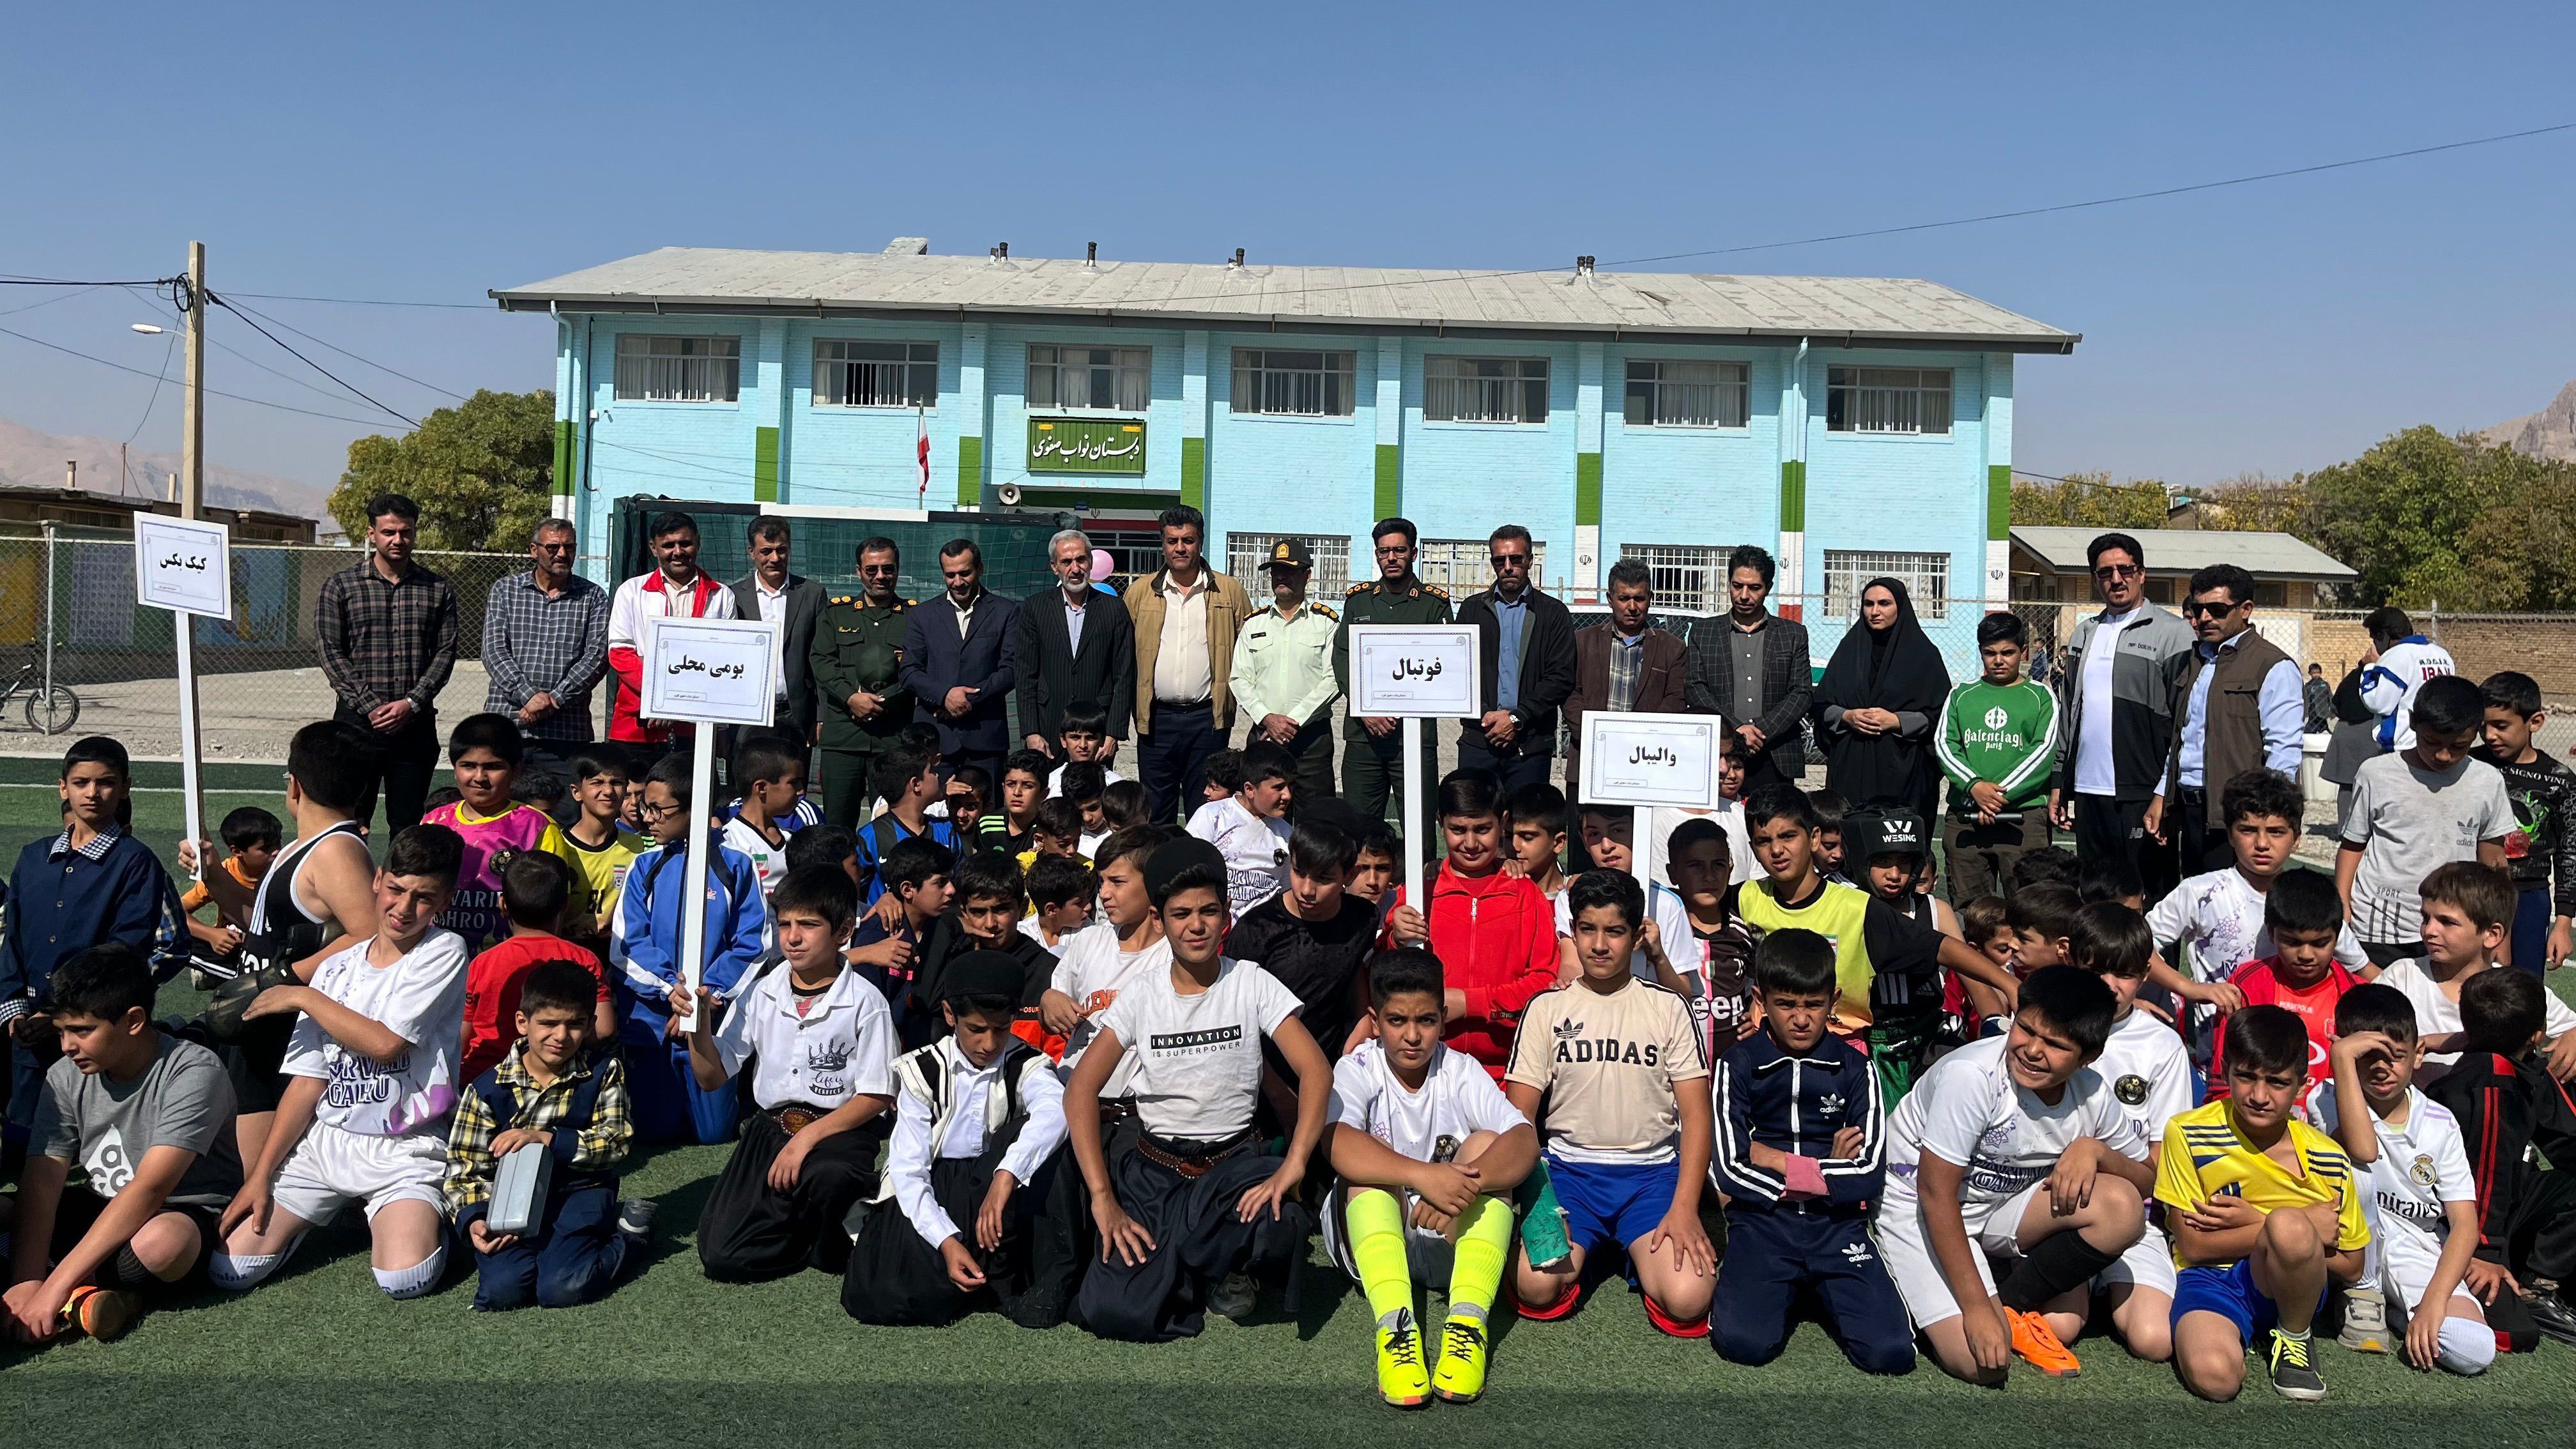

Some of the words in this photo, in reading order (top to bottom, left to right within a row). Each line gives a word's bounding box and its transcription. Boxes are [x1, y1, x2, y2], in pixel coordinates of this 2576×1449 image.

[1032, 435, 1062, 457] صفوی
[1059, 434, 1090, 463] نواب
[1089, 436, 1140, 461] دبستان
[668, 654, 706, 675] محلی
[709, 663, 744, 680] بومی
[1392, 656, 1442, 682] فوتبال
[1629, 745, 1676, 767] والیبال
[2510, 767, 2542, 780] SIGNO
[1882, 834, 1917, 843] WESING
[2456, 838, 2474, 847] adida
[451, 889, 502, 908] VARI
[2377, 886, 2400, 899] SPORT
[1691, 995, 1744, 1026] eep
[1152, 1028, 1239, 1046] INNOVATION
[1166, 1041, 1241, 1057] SUPERPOWER
[1556, 1038, 1658, 1067] ADIDAS
[815, 1087, 841, 1095] PERFECT
